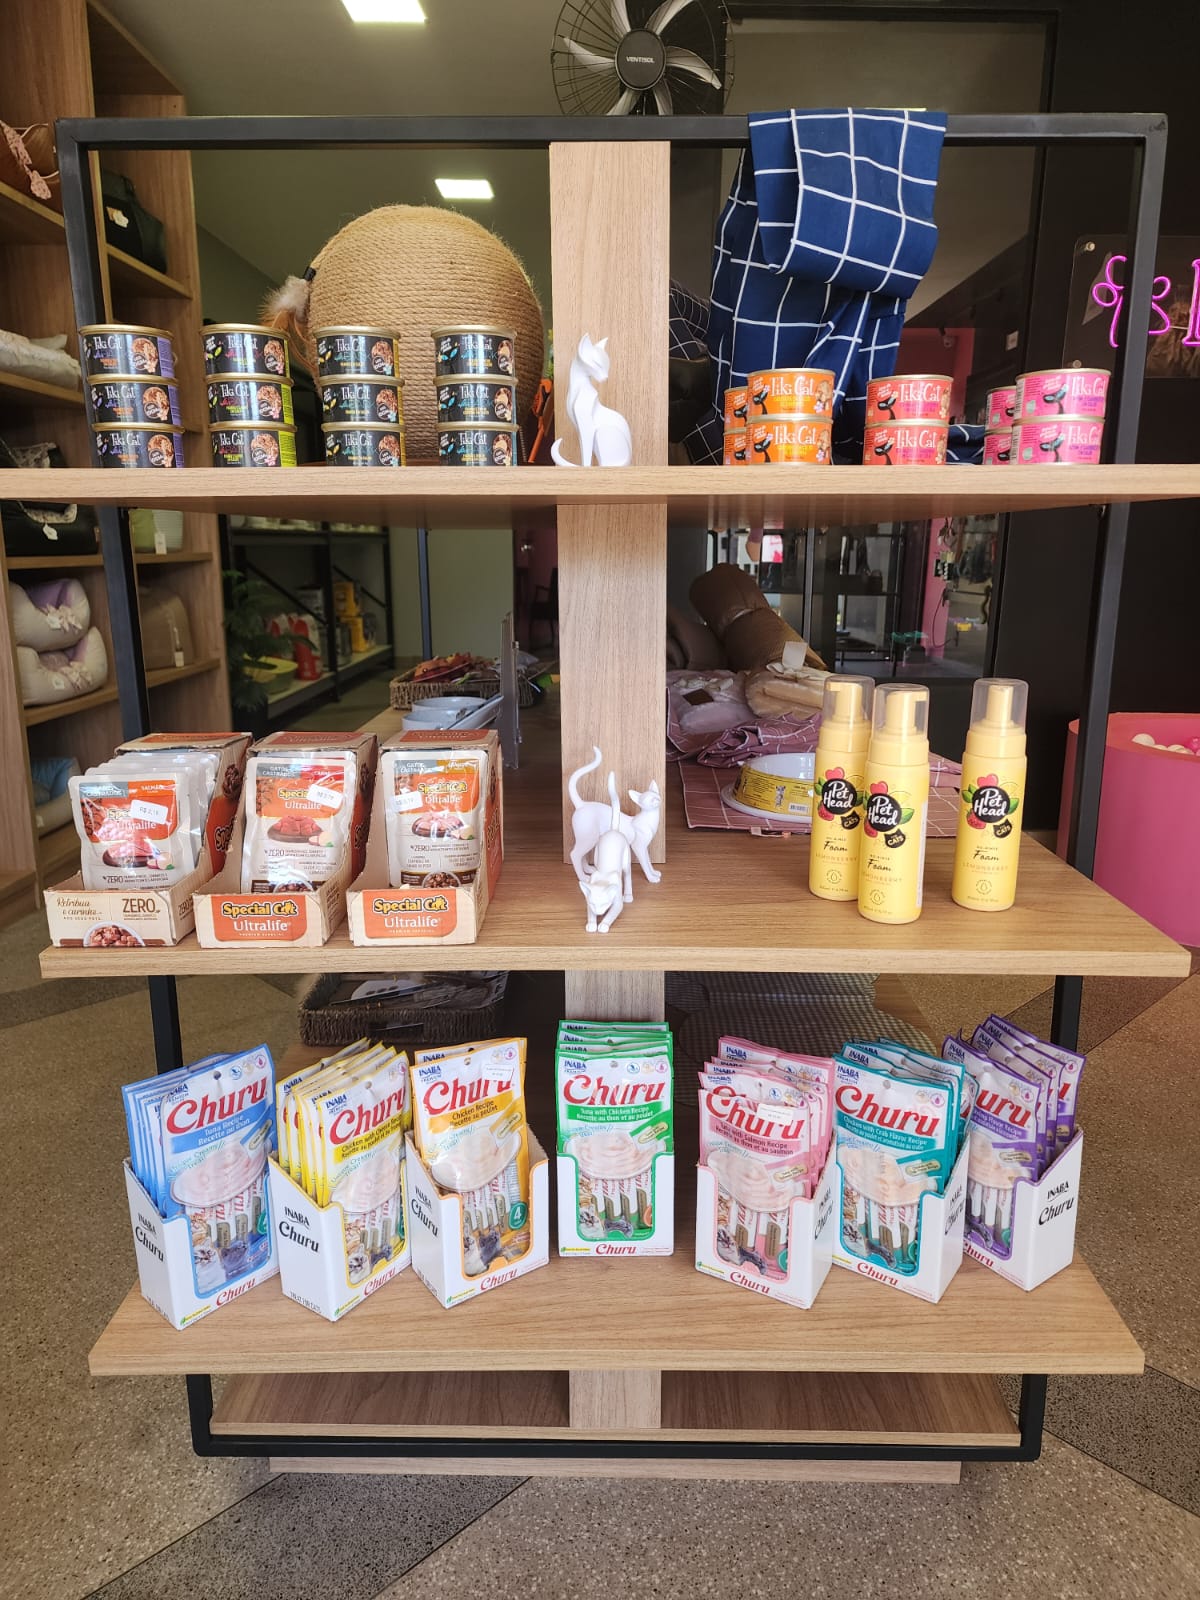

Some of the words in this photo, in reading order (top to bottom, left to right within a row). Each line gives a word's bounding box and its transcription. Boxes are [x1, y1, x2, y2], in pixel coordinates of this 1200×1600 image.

[771, 377, 793, 397] Tiki
[794, 375, 815, 396] Cat
[899, 383, 922, 403] Tiki
[923, 383, 941, 402] Cat
[1071, 376, 1093, 397] Tiki
[773, 425, 796, 445] Tiki
[797, 425, 817, 445] Cat
[895, 430, 918, 449] Tiki
[918, 430, 938, 449] Cat
[1067, 425, 1089, 446] Tiki
[1089, 426, 1102, 445] Ca
[278, 788, 309, 800] Specia
[823, 790, 854, 808] Head
[828, 780, 849, 799] Pet
[980, 787, 1002, 807] Pet
[872, 795, 893, 816] Pet
[974, 798, 1007, 817] Head
[867, 807, 898, 826] Head
[824, 840, 848, 852] Foam
[867, 858, 892, 872] Foam
[973, 850, 999, 862] Foam
[107, 875, 123, 884] ZERO
[122, 898, 156, 913] ZERO
[222, 901, 272, 919] Special
[273, 900, 298, 916] Cat
[373, 898, 422, 914] Special
[423, 895, 448, 911] Cat
[233, 919, 288, 932] Ultralife
[384, 915, 439, 928] Ultralife
[978, 1032, 994, 1050] INABA
[986, 1025, 1003, 1040] INABA
[423, 1053, 445, 1062] INABA
[726, 1046, 747, 1057] INABA
[849, 1050, 869, 1065] INABA
[949, 1044, 966, 1059] INABA
[418, 1065, 442, 1077] INABA
[564, 1060, 587, 1069] INABA
[837, 1065, 859, 1078] INABA
[283, 1077, 302, 1091] INABA
[563, 1074, 666, 1106] Churu
[166, 1077, 268, 1135] Churu
[326, 1093, 347, 1109] INABA
[423, 1077, 514, 1116] Churu
[452, 1108, 475, 1121] Chicken
[476, 1100, 494, 1112] Recipe
[480, 1104, 498, 1117] poulet
[608, 1108, 630, 1116] Chicken
[835, 1085, 941, 1137] Churu
[975, 1089, 1031, 1127] uru
[198, 1129, 225, 1146] Recette
[236, 1118, 250, 1131] thon
[205, 1126, 221, 1137] Tuna
[222, 1115, 243, 1129] Recipe
[843, 1116, 863, 1129] Chicken
[863, 1123, 875, 1134] with
[875, 1128, 889, 1138] Crab
[889, 1132, 907, 1143] Flavor
[908, 1136, 928, 1146] Recipe
[341, 1139, 363, 1153] Chicken
[365, 1131, 375, 1142] with
[732, 1128, 743, 1138] with
[744, 1133, 766, 1147] Salmon
[767, 1141, 788, 1150] Recipe
[769, 1146, 794, 1156] saumon
[1047, 1181, 1070, 1200] INABA
[284, 1206, 310, 1226] INABA
[411, 1198, 438, 1237] Churu
[513, 1206, 522, 1220] 4
[1038, 1197, 1075, 1226] Churu
[135, 1225, 164, 1262] Churu
[279, 1221, 319, 1253] Churu
[595, 1243, 637, 1255] Churu
[364, 1267, 396, 1296] Churu
[480, 1269, 518, 1291] Churu
[729, 1271, 771, 1295] Churu
[857, 1262, 899, 1287] Churu
[216, 1278, 256, 1306] Churu
